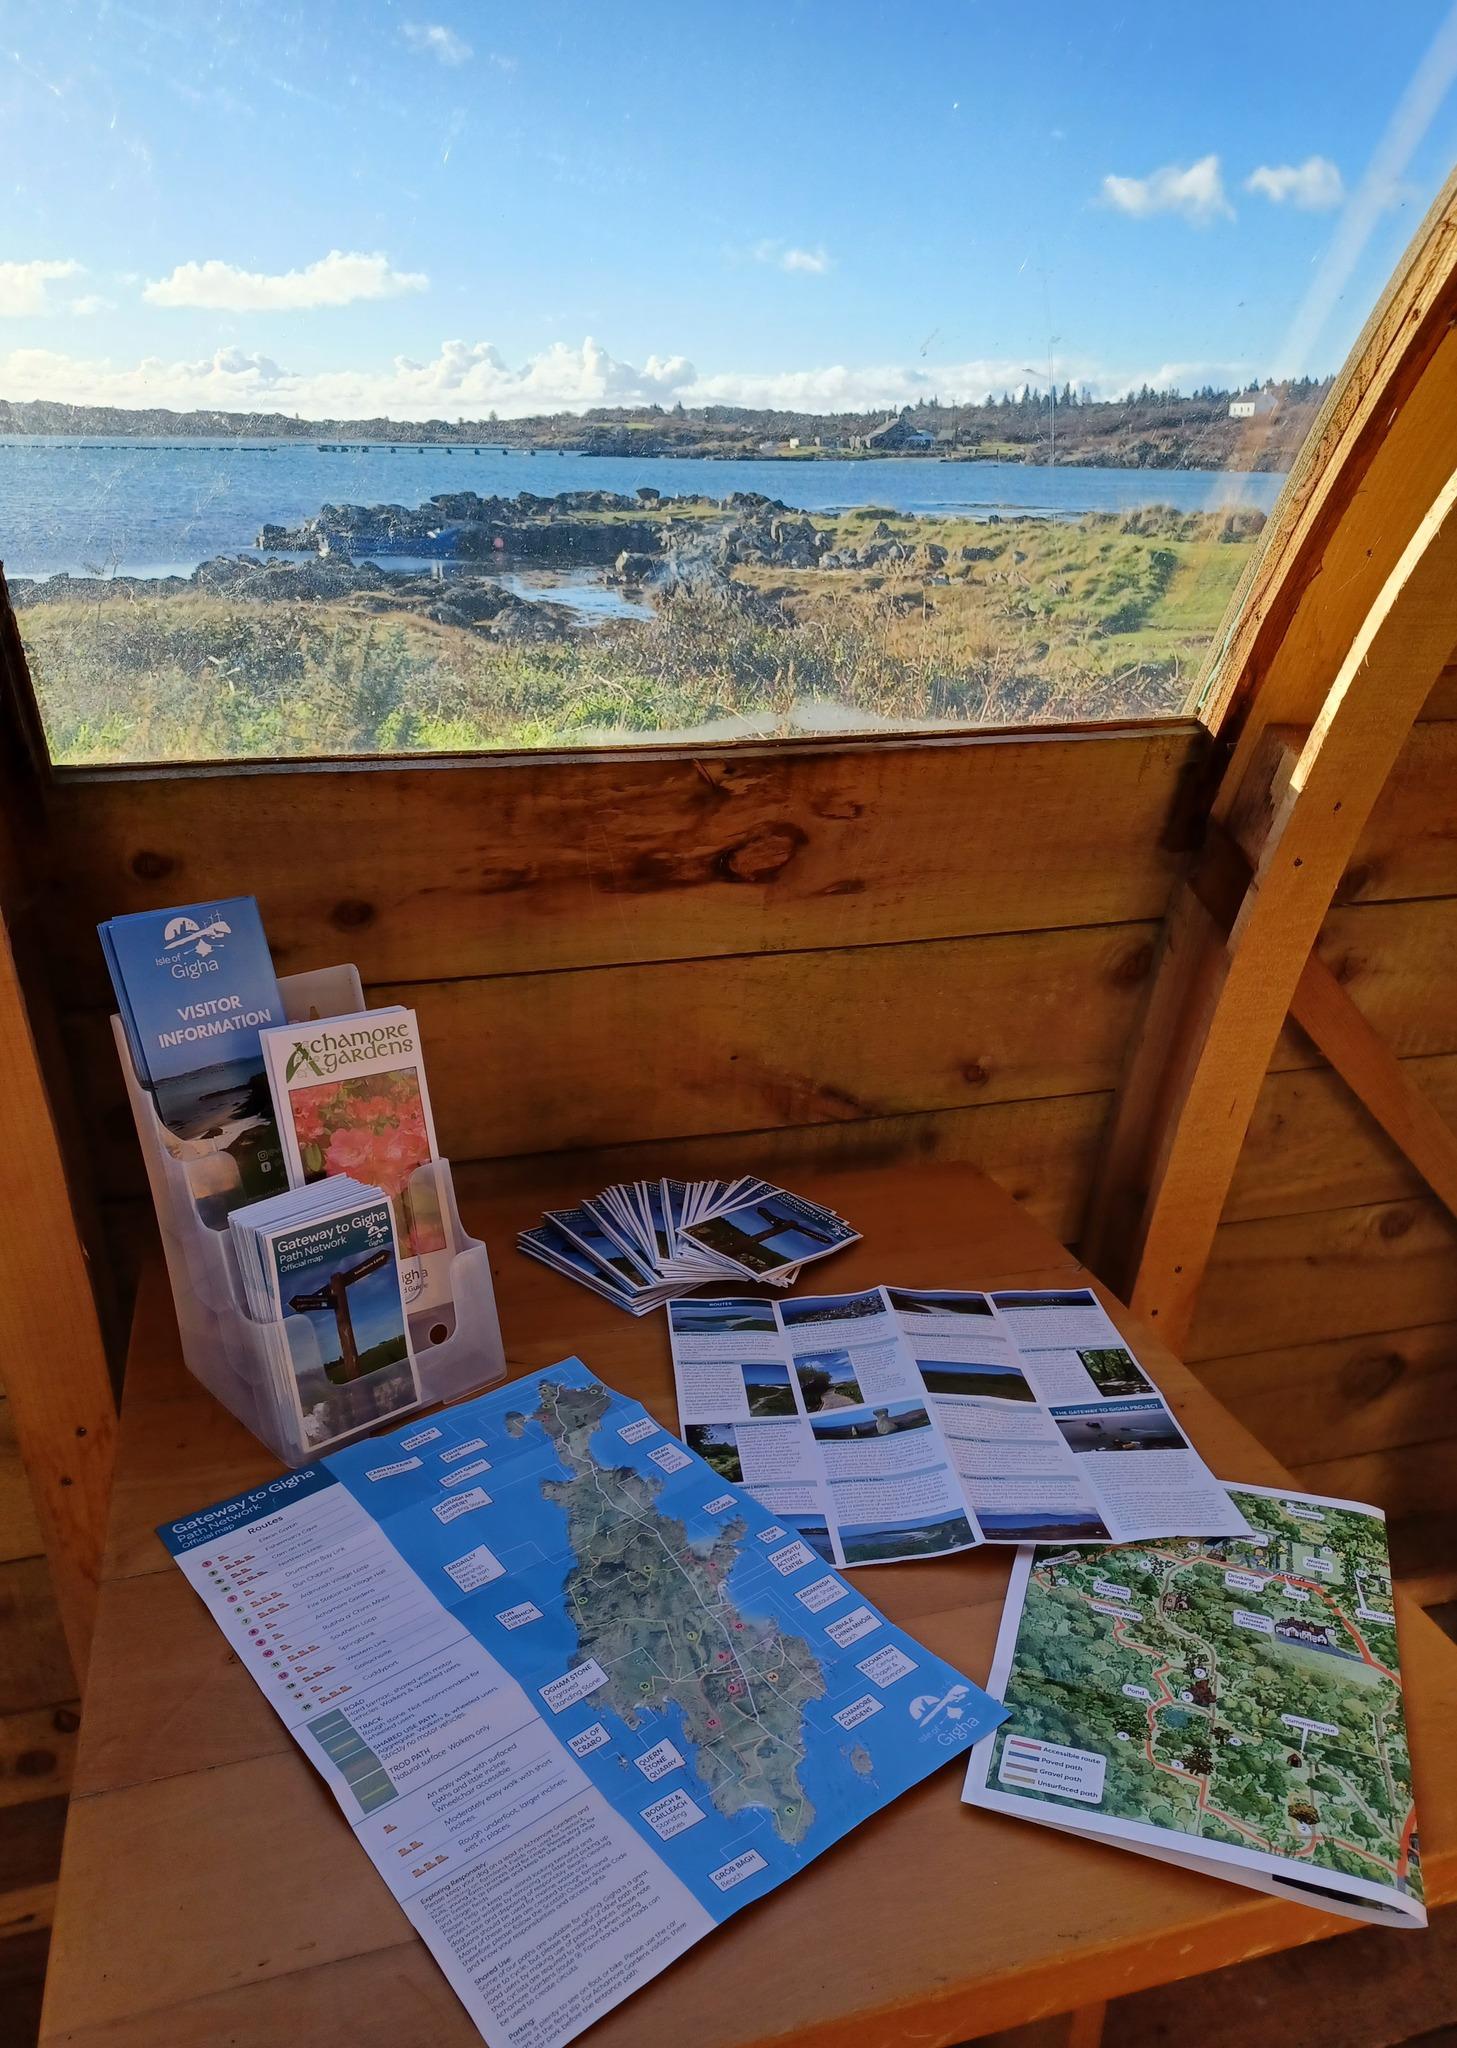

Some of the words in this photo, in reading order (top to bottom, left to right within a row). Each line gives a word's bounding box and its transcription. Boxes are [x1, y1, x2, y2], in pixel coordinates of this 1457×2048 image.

[155, 957, 171, 965] Isle
[172, 953, 180, 962] of
[171, 959, 219, 979] Gigha
[177, 995, 243, 1021] VISITOR
[158, 1009, 271, 1049] INFORMATION
[277, 1227, 333, 1253] Gateway
[336, 1222, 349, 1235] to
[351, 1211, 387, 1229] Gigha
[280, 1250, 304, 1264] Path
[305, 1236, 347, 1256] Network
[281, 1260, 306, 1272] Official
[307, 1254, 323, 1266] map
[401, 1269, 428, 1285] igha
[172, 1500, 245, 1533] Gateway
[248, 1492, 266, 1502] to
[268, 1471, 315, 1492] Gigha
[177, 1528, 207, 1542] Path
[208, 1504, 261, 1529] Network
[247, 1517, 283, 1534] Routes
[182, 1532, 214, 1548] Official
[215, 1524, 235, 1534] map
[777, 1552, 800, 1568] ACTIVITY
[782, 1559, 804, 1573] CENTRE
[1227, 1573, 1255, 1584] Drinking
[1227, 1578, 1248, 1587] Water
[544, 1678, 570, 1695] OGHAM
[570, 1664, 592, 1680] STONE
[548, 1682, 579, 1703] Engraved
[552, 1689, 583, 1709] Standing
[581, 1678, 600, 1691] Stone
[1127, 1686, 1145, 1696] Pond
[344, 1699, 365, 1712] ROAD
[838, 1697, 872, 1721] ACHAMORE
[358, 1716, 383, 1730] TRACK
[844, 1707, 873, 1726] GARDENS
[1284, 1716, 1336, 1734] Summerhouse
[373, 1732, 402, 1750] SHARED
[403, 1724, 417, 1733] USE
[418, 1713, 436, 1725] PATH
[572, 1735, 591, 1747] BULL
[590, 1727, 599, 1736] OF
[937, 1717, 980, 1745] Gigha
[381, 1745, 405, 1761] Strictly
[417, 1727, 437, 1741] motor
[393, 1763, 421, 1782] Natural
[448, 1734, 475, 1750] Walkers
[475, 1725, 490, 1735] only
[577, 1736, 602, 1753] CRARO
[388, 1759, 411, 1774] TROD
[411, 1747, 430, 1762] PATH
[639, 1747, 663, 1766] QUERN
[644, 1755, 667, 1772] STONE
[1041, 1757, 1064, 1768] Paved
[1065, 1763, 1083, 1772] path
[1043, 1747, 1080, 1760] Accessible
[1081, 1756, 1100, 1764] route
[427, 1791, 437, 1799] An
[438, 1782, 454, 1792] easy
[455, 1771, 472, 1782] walk
[473, 1761, 487, 1773] with
[488, 1743, 517, 1763] surfaced
[649, 1758, 676, 1778] QUARRY
[1039, 1769, 1063, 1778] Gravel
[1064, 1774, 1082, 1783] path
[431, 1793, 449, 1807] paths
[451, 1782, 467, 1795] and
[467, 1773, 483, 1784] little
[444, 1799, 485, 1826] Moderately
[486, 1789, 502, 1801] easy
[503, 1780, 518, 1791] walk
[519, 1770, 535, 1781] with
[535, 1759, 552, 1771] short
[1037, 1780, 1079, 1794] Unsurfaced
[1080, 1789, 1098, 1798] path
[435, 1788, 474, 1812] Wheelchair
[644, 1798, 675, 1818] BODACH
[458, 1830, 483, 1846] Rough
[484, 1808, 520, 1831] underfoot,
[519, 1794, 540, 1809] larger
[650, 1800, 688, 1823] CAILLEACH
[656, 1811, 687, 1829] Standing
[464, 1842, 479, 1853] wet
[420, 1885, 451, 1908] Exploring
[474, 1966, 498, 1985] Shared
[508, 2019, 535, 2040] Parking:
